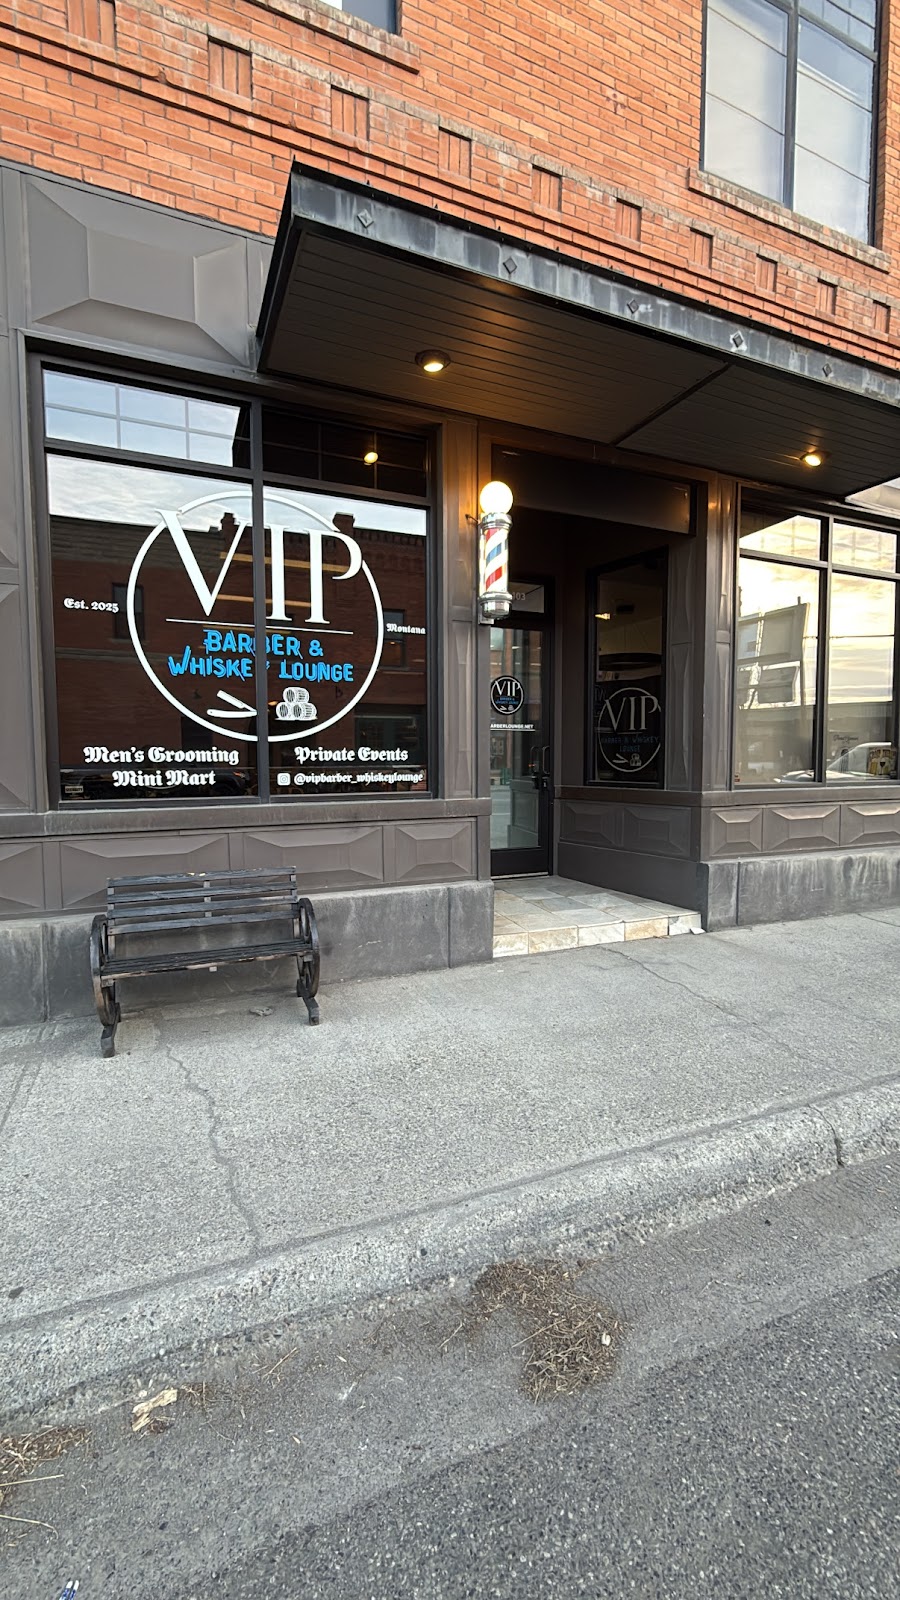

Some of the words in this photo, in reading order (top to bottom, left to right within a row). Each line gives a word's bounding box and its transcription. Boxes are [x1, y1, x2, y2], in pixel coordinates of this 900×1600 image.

[155, 508, 363, 624] VIP
[63, 597, 89, 609] Est.
[90, 601, 119, 613] 2025
[386, 622, 426, 635] Montana
[308, 639, 323, 656] &
[168, 646, 270, 681] WHISKE
[279, 659, 354, 682] LOUNGE
[495, 680, 520, 697] VIP
[604, 695, 659, 731] VIP
[83, 746, 144, 763] Men's
[147, 746, 239, 765] Grooming
[294, 746, 355, 764] Private
[357, 746, 408, 762] Events
[112, 770, 163, 787] Mini
[165, 769, 216, 786] Mart
[294, 772, 424, 786] @vipbarber_whiskeylounge
